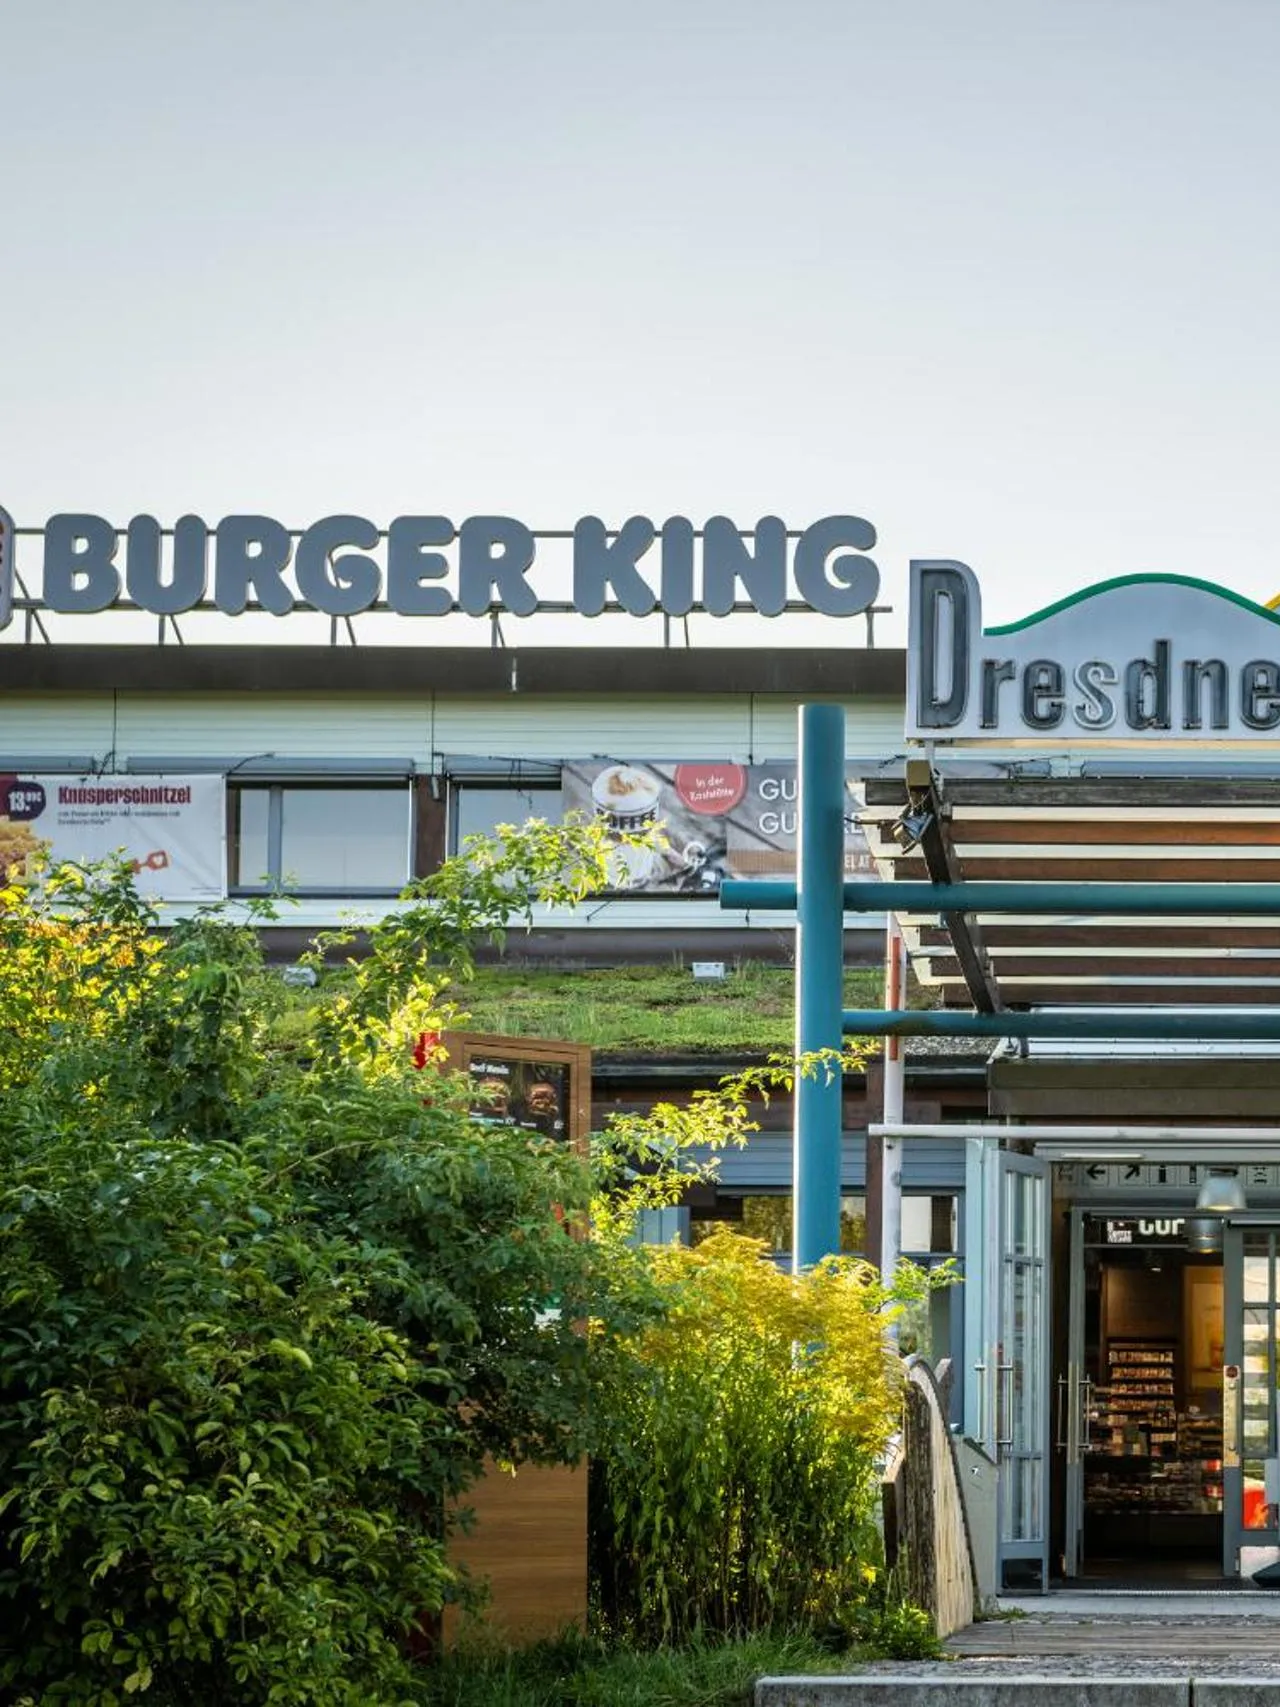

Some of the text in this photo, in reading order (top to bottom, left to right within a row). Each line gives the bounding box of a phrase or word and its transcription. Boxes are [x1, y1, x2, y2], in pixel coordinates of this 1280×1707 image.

[43, 512, 882, 617] BURGER KING
[58, 785, 192, 805] Knusperschnitzel
